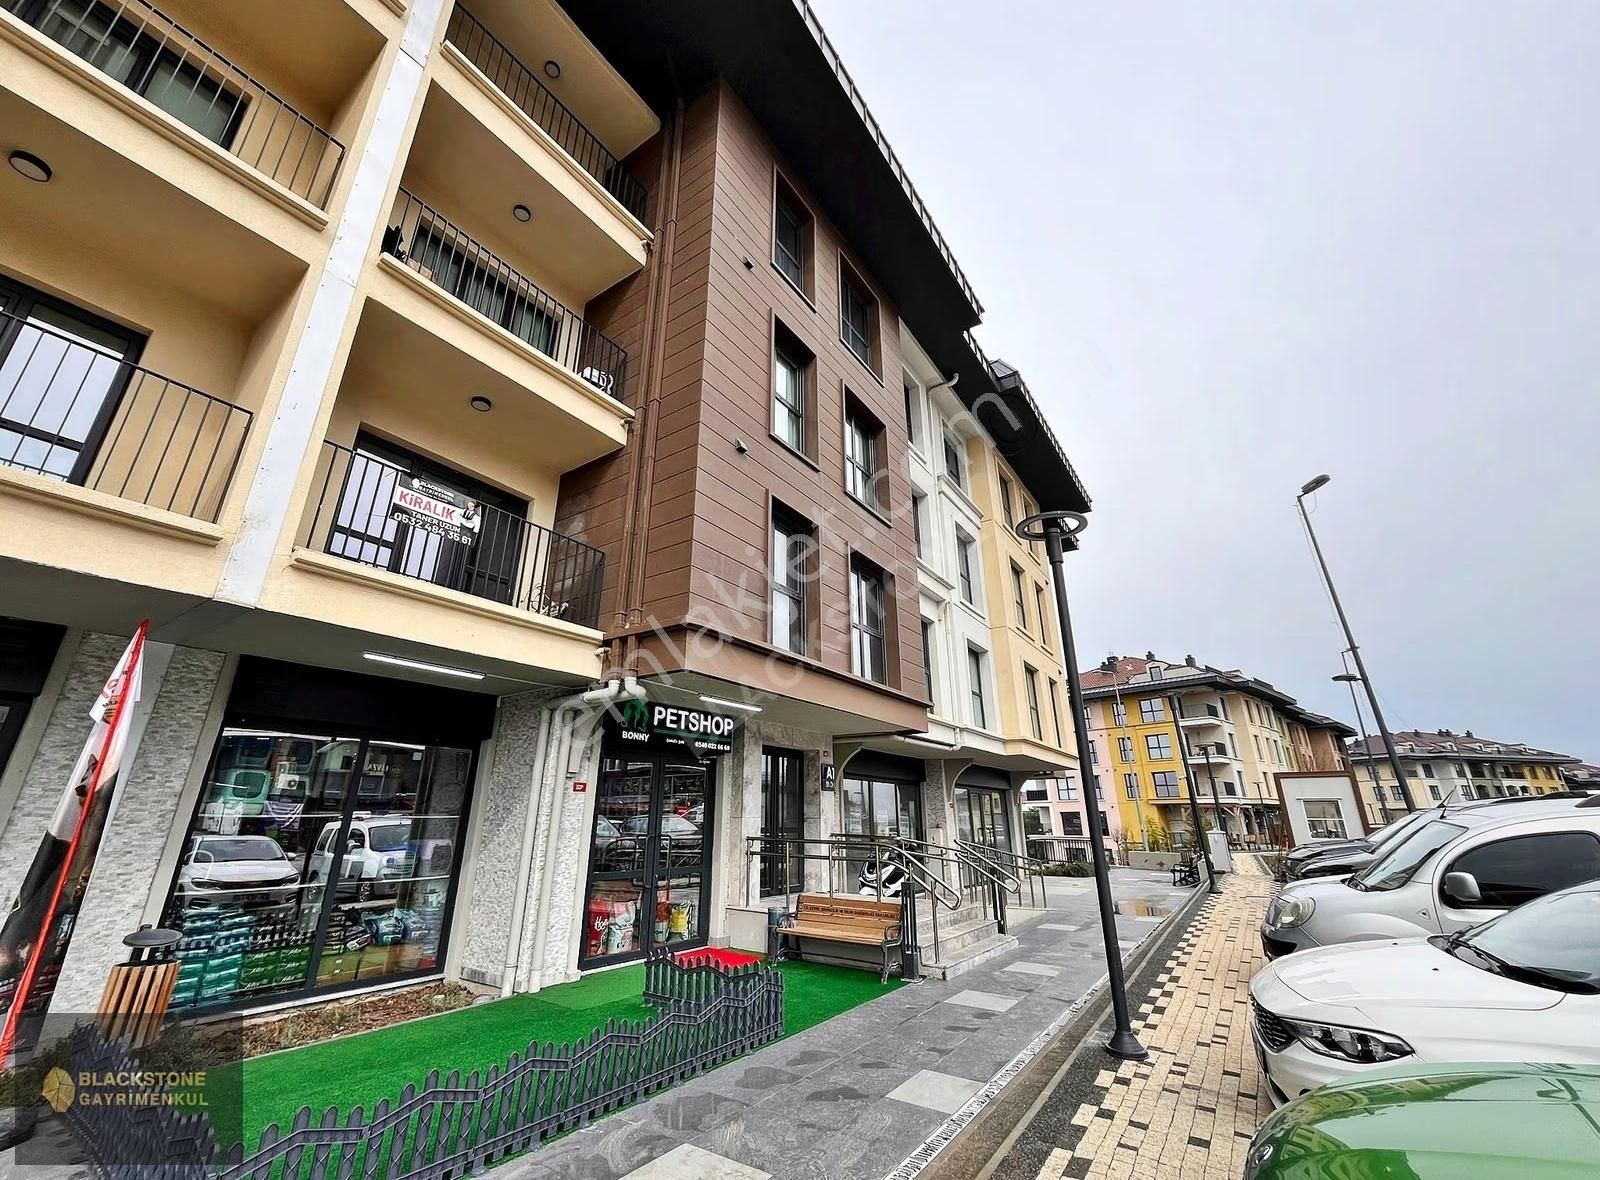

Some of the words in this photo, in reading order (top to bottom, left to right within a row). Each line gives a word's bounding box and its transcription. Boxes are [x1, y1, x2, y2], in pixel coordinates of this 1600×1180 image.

[393, 512, 422, 528] 0532
[424, 524, 445, 537] 484
[447, 531, 460, 541] 35
[411, 510, 438, 526] TANER
[439, 521, 461, 533] UZUN
[653, 706, 734, 736] PETSHOP
[622, 730, 650, 742] BONNY
